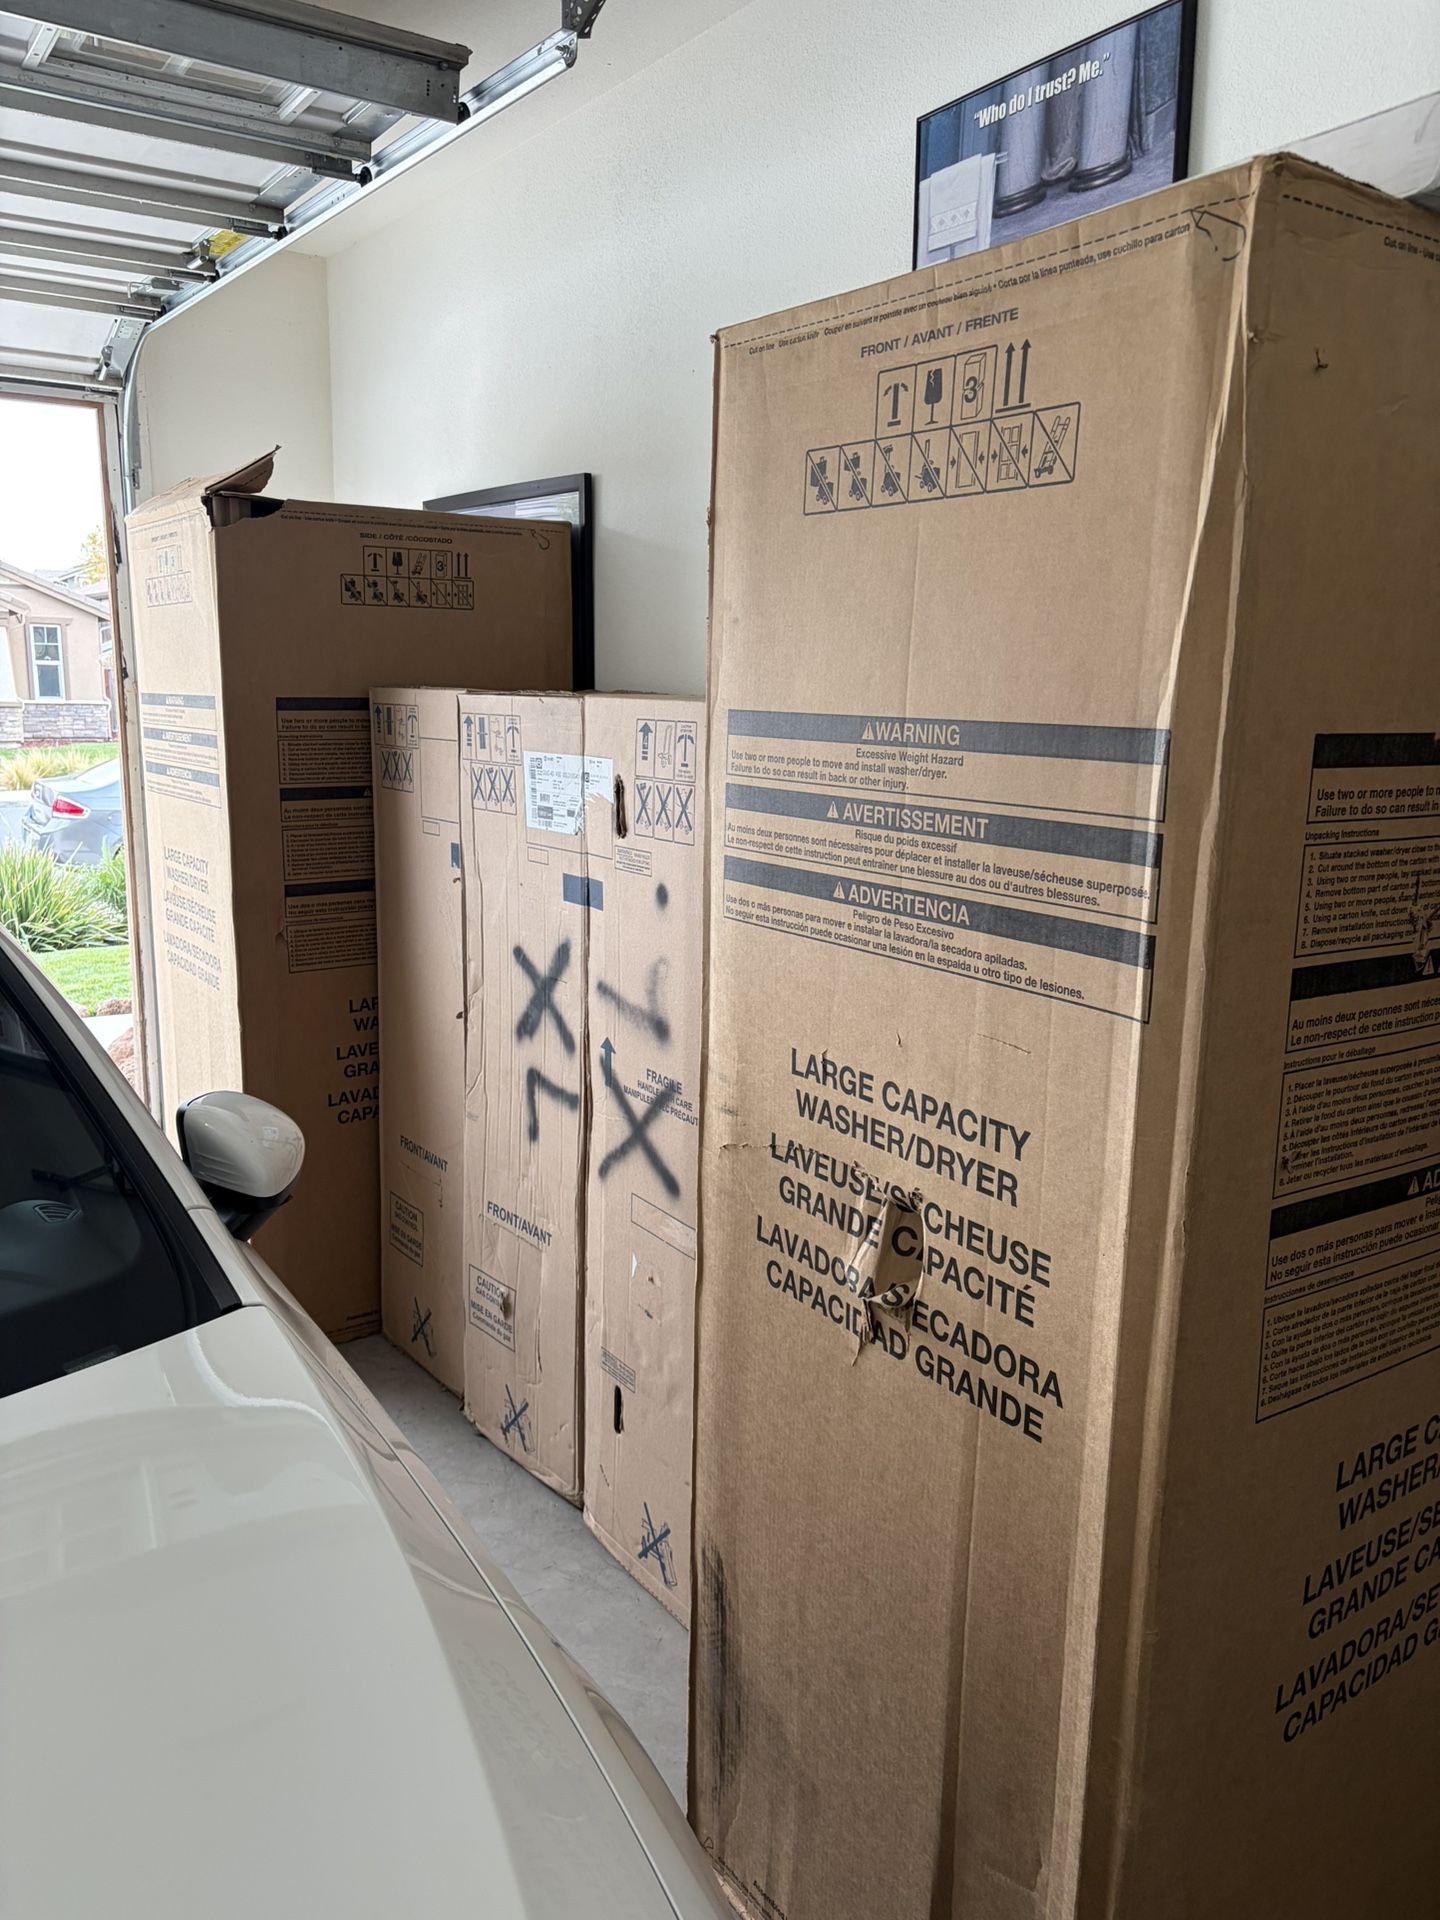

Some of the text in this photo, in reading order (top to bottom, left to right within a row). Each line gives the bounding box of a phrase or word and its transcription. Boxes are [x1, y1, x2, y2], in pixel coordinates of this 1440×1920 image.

[1009, 93, 1024, 115] do
[1027, 87, 1032, 107] I
[1034, 68, 1076, 102] trust?
[860, 337, 901, 357] FRONT
[911, 324, 954, 345] AVANT
[965, 307, 1018, 331] FRENTE
[963, 376, 978, 404] 3
[875, 722, 960, 745] WARNING
[730, 762, 909, 791] Failure to do so can result in back or other injury.
[731, 750, 742, 760] Use
[744, 751, 757, 761] two
[767, 755, 785, 763] more
[786, 756, 811, 767] people
[812, 757, 821, 767] to
[820, 760, 842, 769] move
[844, 760, 859, 771] and
[861, 761, 885, 772] install
[887, 765, 947, 779] washer/dryer.
[855, 747, 963, 766] Excessive Weight Hazard
[1315, 800, 1439, 816] Failure to do so can result in
[1317, 785, 1437, 800] Use two or more people to
[843, 804, 988, 838] AVERTISSEMENT
[855, 829, 957, 852] Risque du poids excessif
[736, 825, 755, 835] moins
[756, 827, 772, 837] deux
[773, 831, 809, 843] personnes
[810, 837, 827, 846] sont
[828, 839, 873, 854] nécessaires
[874, 847, 893, 857] pour
[894, 848, 931, 863] déplacer
[933, 855, 942, 865] et
[944, 855, 980, 870] installer
[982, 861, 990, 873] la
[992, 863, 1083, 887] laveuse/sécheuse
[848, 883, 969, 924] ADVERTENCIA
[852, 910, 954, 939] Peligro de Peso Excesivo
[725, 905, 1084, 999] No seguir esta instrucción puede ocasionar una lesión en la espalda u otro tipo de lesiones.
[726, 894, 737, 904] Use
[738, 897, 749, 907] dos
[771, 906, 803, 919] personas
[804, 913, 821, 923] para
[822, 917, 845, 928] mover
[846, 922, 852, 930] e
[853, 922, 882, 936] instalar
[883, 928, 891, 939] la
[893, 931, 939, 950] lavadora/la
[940, 944, 982, 960] secadora
[984, 953, 1027, 970] apiladas.
[1291, 999, 1423, 1030] Au moins deux personnes sont
[647, 1068, 682, 1095] FRAGILE
[676, 1097, 693, 1112] CARE
[791, 1047, 1030, 1160] LARGE CAPACITY
[400, 1135, 448, 1171] FRONT/AVANT
[796, 1089, 1018, 1206] WASHER/DRYER
[487, 1201, 552, 1246] FRONT/AVANT
[779, 1176, 882, 1248] GRANDE
[915, 1345, 1044, 1442] GRANDE
[1336, 1424, 1419, 1491] LARGE
[1338, 1453, 1440, 1530] WASHER
[1308, 1555, 1409, 1639] GRANDE
[1275, 1583, 1440, 1714] LAVADORA/SE
[1283, 1632, 1418, 1743] CAPACIDAD
